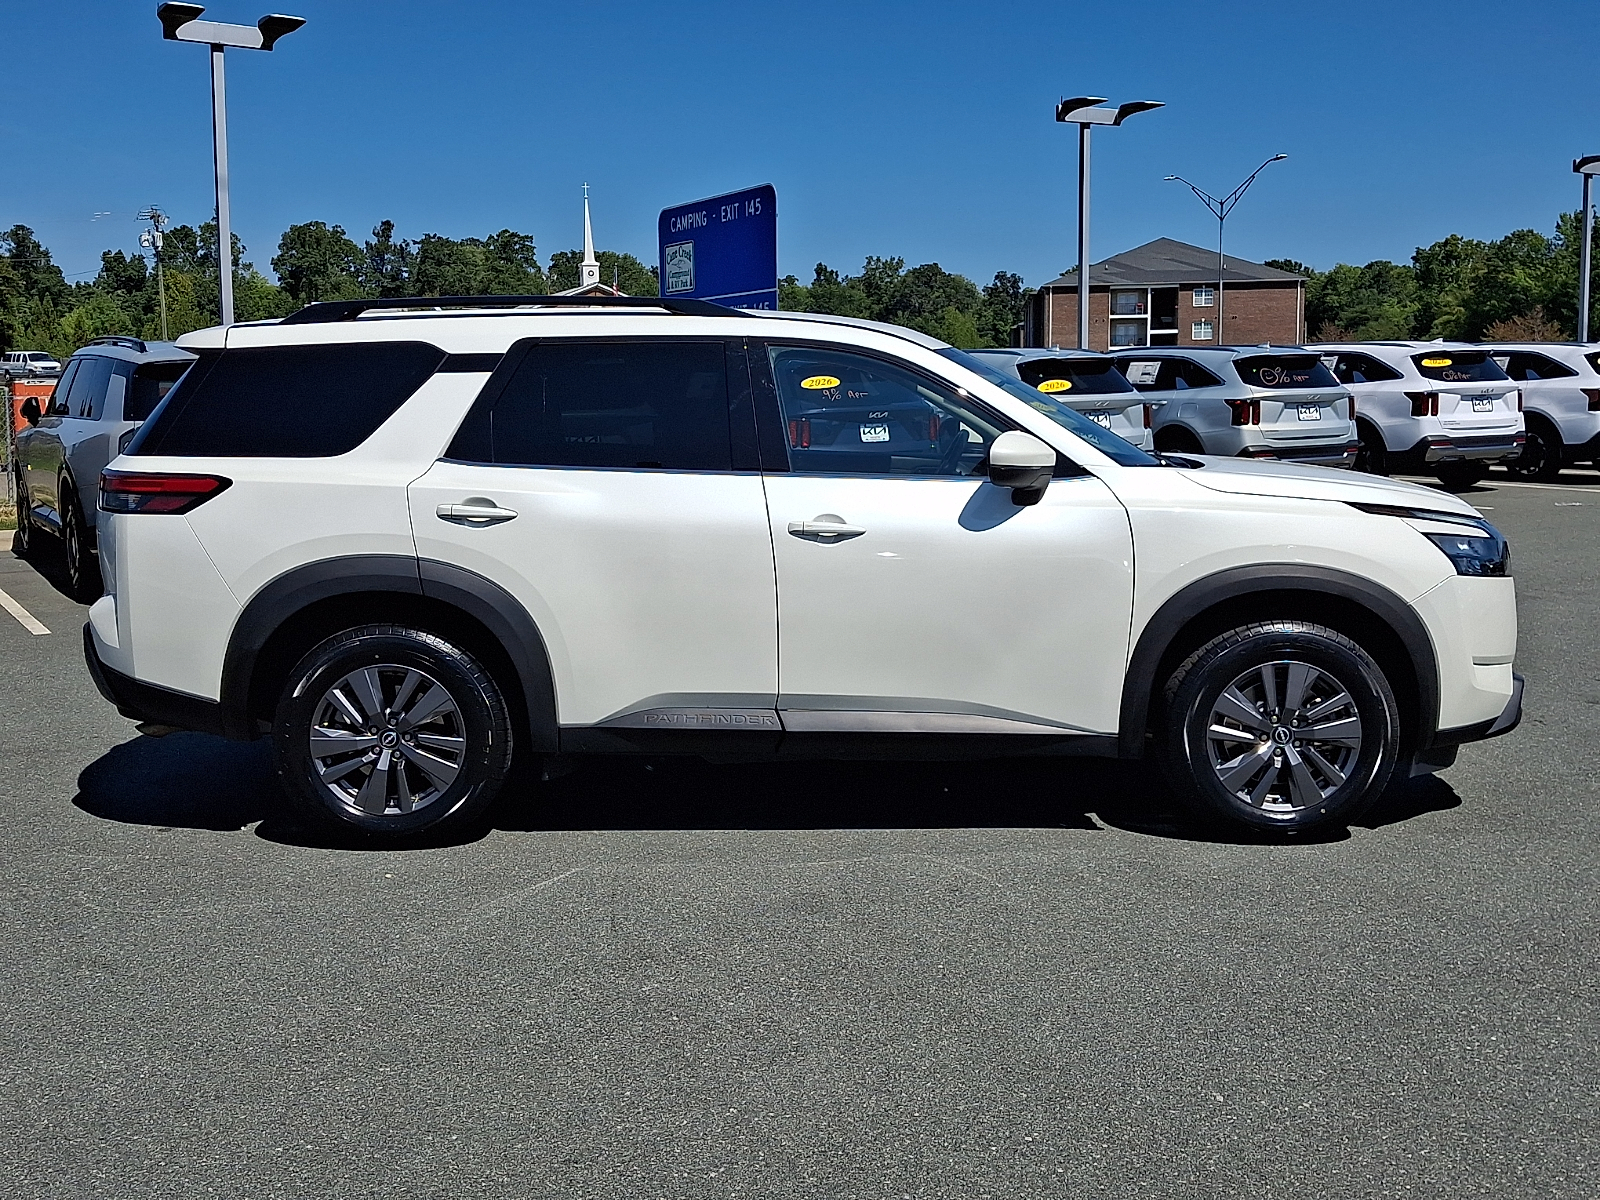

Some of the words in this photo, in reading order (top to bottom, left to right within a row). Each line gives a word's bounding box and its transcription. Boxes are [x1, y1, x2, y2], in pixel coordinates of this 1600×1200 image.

[671, 211, 707, 232] CAMPING
[721, 203, 739, 222] EXIT
[745, 198, 761, 217] 145
[808, 379, 832, 387] 2026
[1045, 382, 1065, 390] 2026
[863, 427, 886, 435] KIA
[644, 714, 774, 725] PATHFINDER
